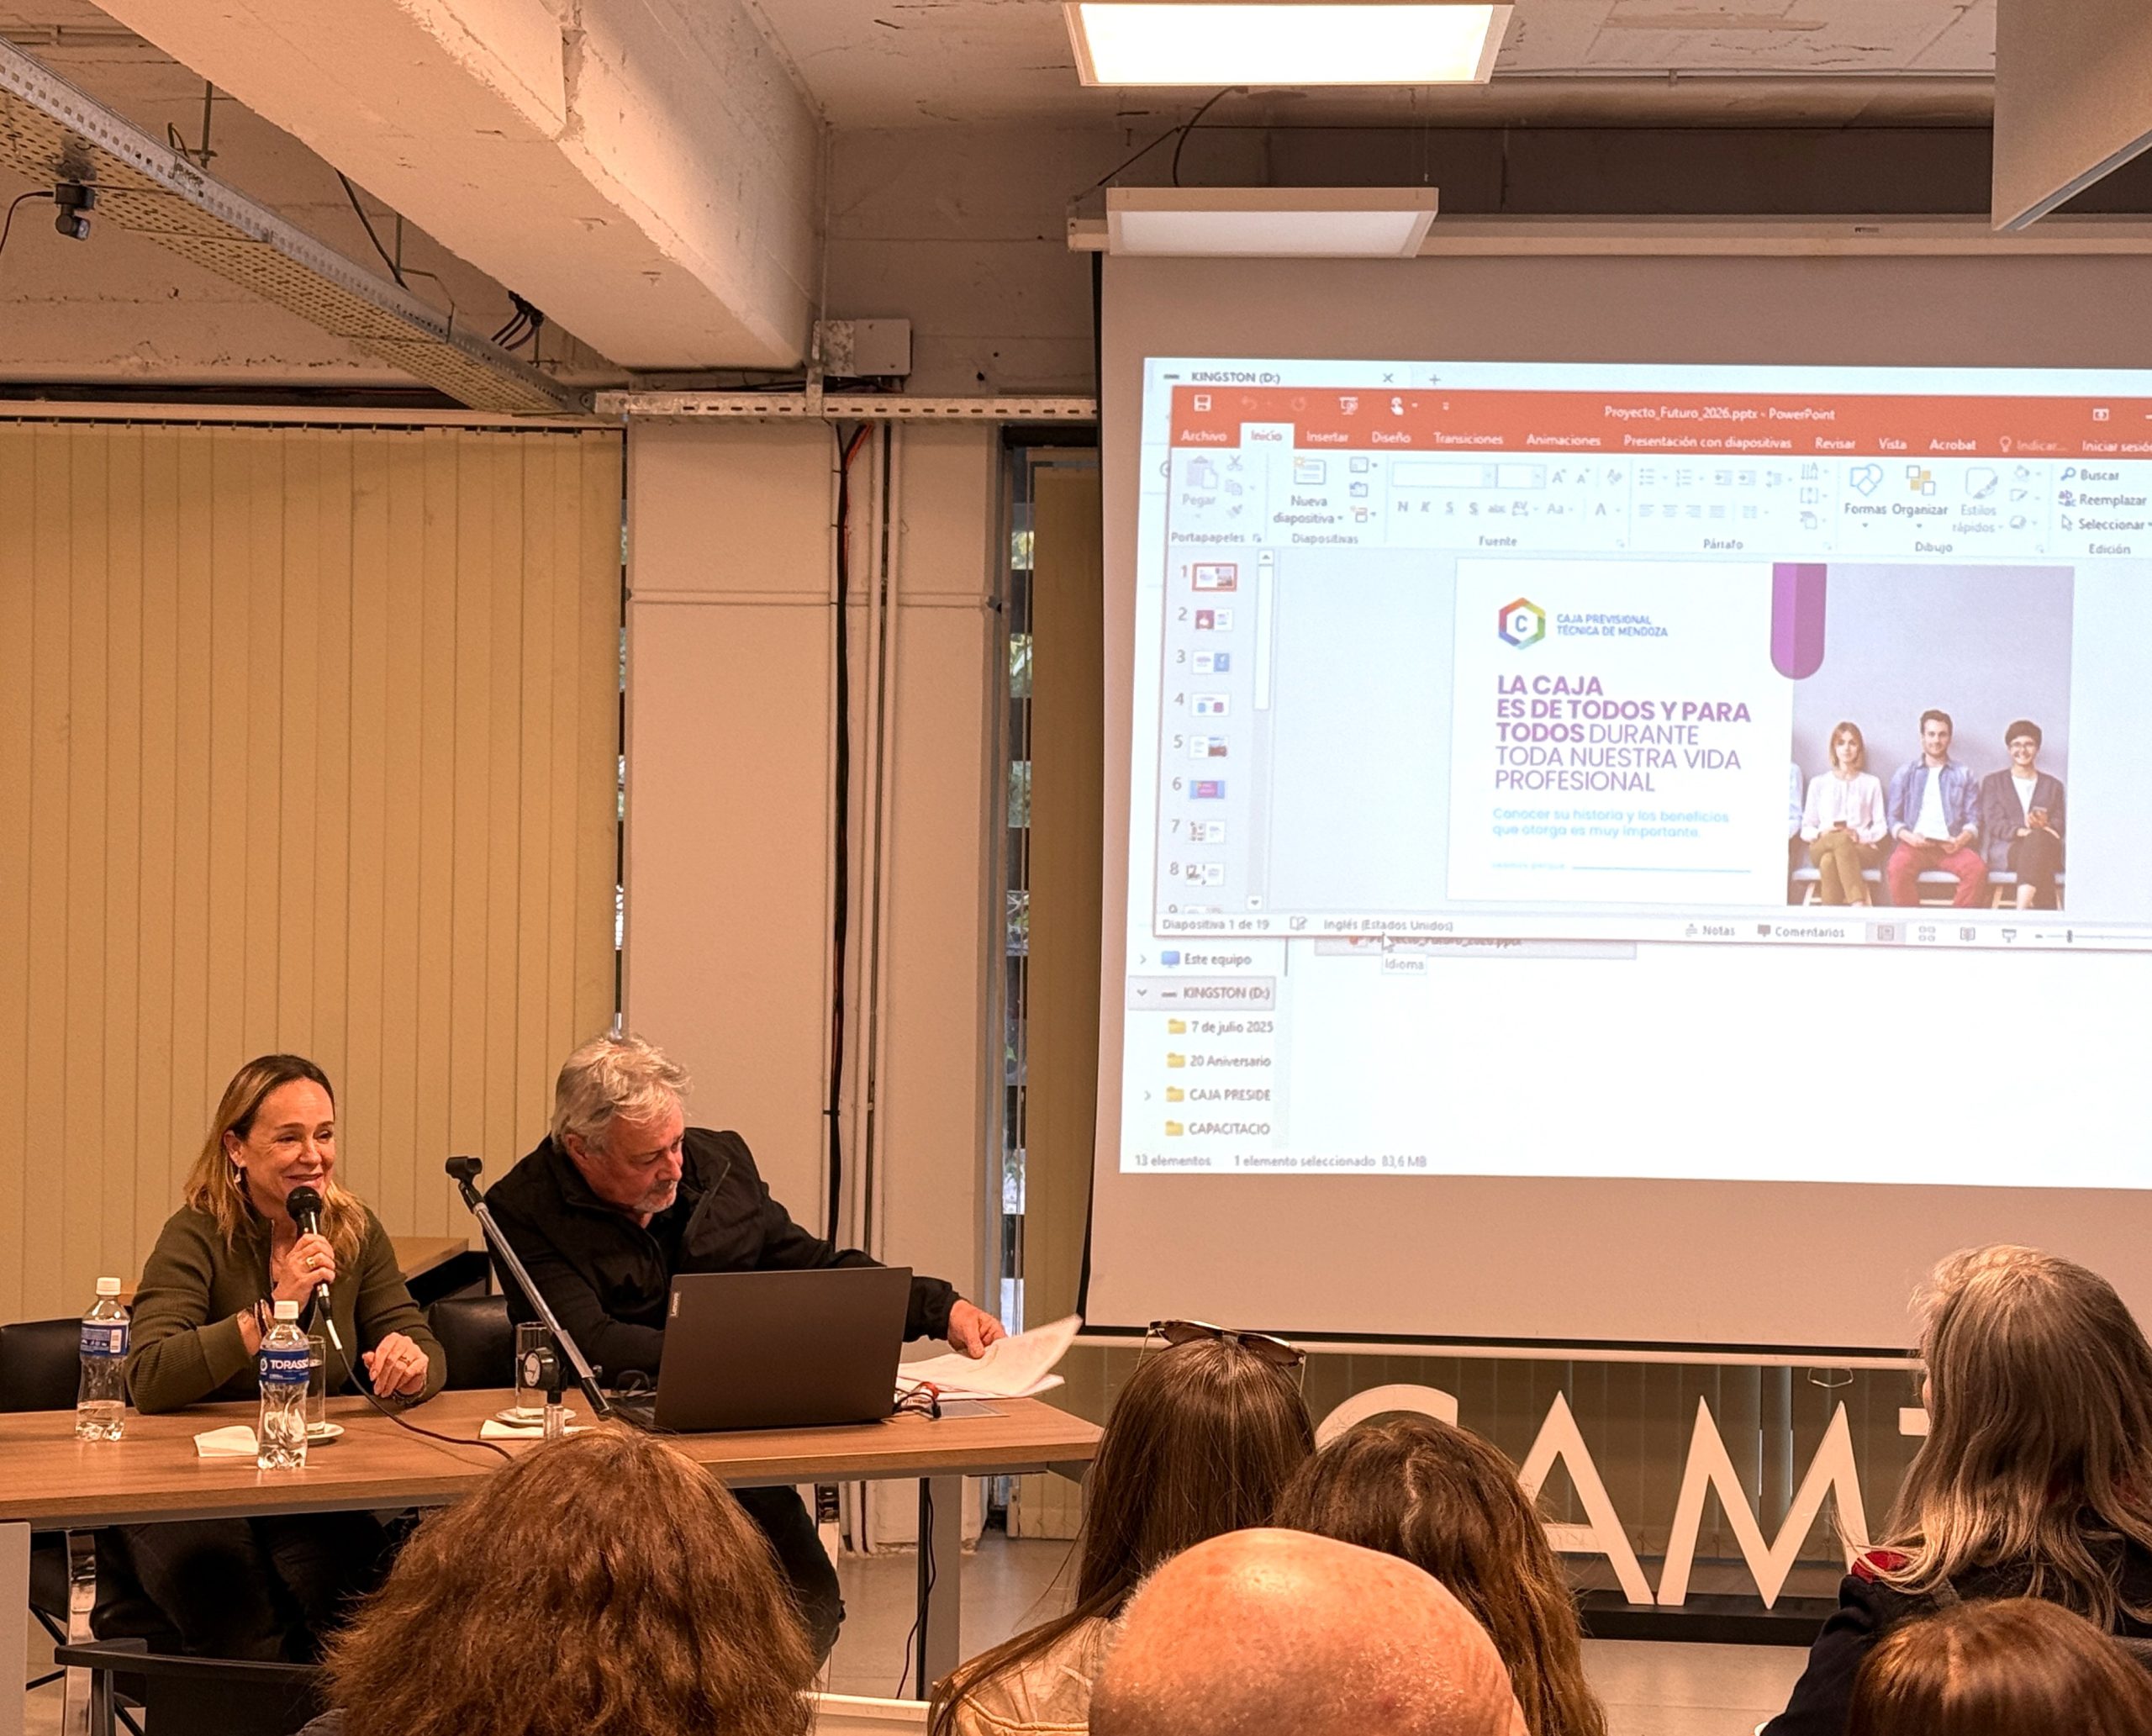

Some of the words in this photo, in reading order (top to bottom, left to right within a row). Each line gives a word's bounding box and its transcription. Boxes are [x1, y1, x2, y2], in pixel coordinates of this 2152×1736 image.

[1191, 372, 1256, 383] KINGSTON
[1259, 372, 1280, 384] (D:)
[1604, 405, 1757, 421] Proyecto_Futuro_2026.pptx
[1769, 407, 1836, 420] PowerPoint
[1181, 429, 1227, 442] Archivo
[1251, 429, 1282, 442] Inicio
[1306, 430, 1349, 443] Insertar
[1372, 430, 1411, 443] Diseño
[1432, 431, 1504, 445] Transiciones
[1526, 433, 1601, 446] Animaciones
[1623, 434, 1697, 448] Presentación
[1700, 438, 1722, 448] con
[1725, 435, 1792, 450] diapositivas
[1815, 435, 1856, 450] Revisar
[1879, 437, 1907, 451] Vista
[1929, 438, 1977, 451] Acrobat
[2082, 440, 2118, 452] Iniciar
[2081, 468, 2119, 481] Buscar
[1182, 493, 1216, 509] Pegar
[1290, 494, 1327, 507] Nueva
[2079, 493, 2147, 509] Reemplazar
[1844, 502, 1887, 514] Formas
[1891, 503, 1949, 518] Organizar
[1960, 504, 1996, 516] Estilos
[1273, 512, 1335, 525] diapositiva
[2078, 518, 2144, 530] Seleccionar
[1952, 522, 1995, 534] rápidos
[1171, 531, 1245, 545] Portapapeles
[1291, 532, 1358, 546] Diapositivas
[1479, 535, 1517, 546] Fuente
[1703, 537, 1744, 550] Párrafo
[1915, 541, 1954, 554] Dibujo
[2088, 542, 2131, 555] Edición
[1180, 565, 1188, 578] 1
[1178, 608, 1187, 621] 2
[1556, 613, 1583, 624] CAJA
[1585, 614, 1652, 625] PREVISIONAL
[1515, 615, 1528, 633] C
[1556, 625, 1600, 636] TÉCNICA
[1601, 625, 1615, 636] DE
[1618, 626, 1669, 637] MENDOZA
[1176, 650, 1186, 663] 3
[1497, 674, 1527, 695] LA
[1532, 675, 1604, 696] CAJA
[1174, 693, 1184, 705] 4
[1497, 699, 1526, 719] ES
[1531, 699, 1562, 720] DE
[1567, 699, 1656, 720] TODOS
[1660, 700, 1678, 721] Y
[1682, 701, 1752, 723] PARA
[1496, 722, 1585, 743] TODOS
[1590, 723, 1699, 746] DURANTE
[1173, 736, 1183, 748] 5
[1495, 746, 1564, 767] TODA
[1570, 747, 1678, 769] NUESTRA
[1684, 748, 1741, 769] VIDA
[1172, 778, 1182, 791] 6
[1495, 769, 1655, 792] PROFESIONAL
[1492, 808, 1550, 821] Conocer
[1554, 810, 1570, 821] su
[1573, 808, 1623, 821] historia
[1627, 811, 1635, 824] y
[1638, 809, 1656, 821] los
[1660, 809, 1730, 823] beneficios
[1171, 820, 1180, 833] 7
[1492, 826, 1519, 838] que
[1522, 825, 1567, 839] otorga
[1570, 826, 1585, 836] es
[1589, 826, 1619, 839] muy
[1169, 863, 1179, 876] 8
[1163, 919, 1226, 931] Diapositiva
[1229, 919, 1234, 930] 1
[1238, 919, 1253, 930] de
[1257, 919, 1269, 930] 19
[1324, 918, 1358, 932] Inglés
[1361, 919, 1407, 931] (Estados
[1410, 920, 1453, 933] Unidos)
[1702, 925, 1735, 937] Notas
[1775, 926, 1845, 938] Comentarios
[1184, 952, 1208, 965] Este
[1210, 953, 1253, 968] equipo
[1385, 958, 1424, 970] Idioma
[1184, 987, 1247, 1000] KINGSTON
[1249, 987, 1270, 1000] (D:)
[1191, 1021, 1199, 1033] 7
[1201, 1021, 1216, 1033] de
[1216, 1021, 1244, 1036] julio
[1246, 1021, 1274, 1033] 2025
[1189, 1054, 1205, 1067] 20
[1206, 1054, 1272, 1068] Aniversario
[1189, 1088, 1221, 1101] CAJA
[1224, 1088, 1271, 1101] PRESIDE
[1189, 1121, 1271, 1135] CAPACITACIO
[1135, 1154, 1148, 1167] 13
[1151, 1154, 1211, 1167] elementos
[1234, 1154, 1240, 1167] 1
[1243, 1154, 1297, 1167] elemento
[1300, 1154, 1376, 1167] seleccionado
[1407, 1155, 1427, 1168] MB
